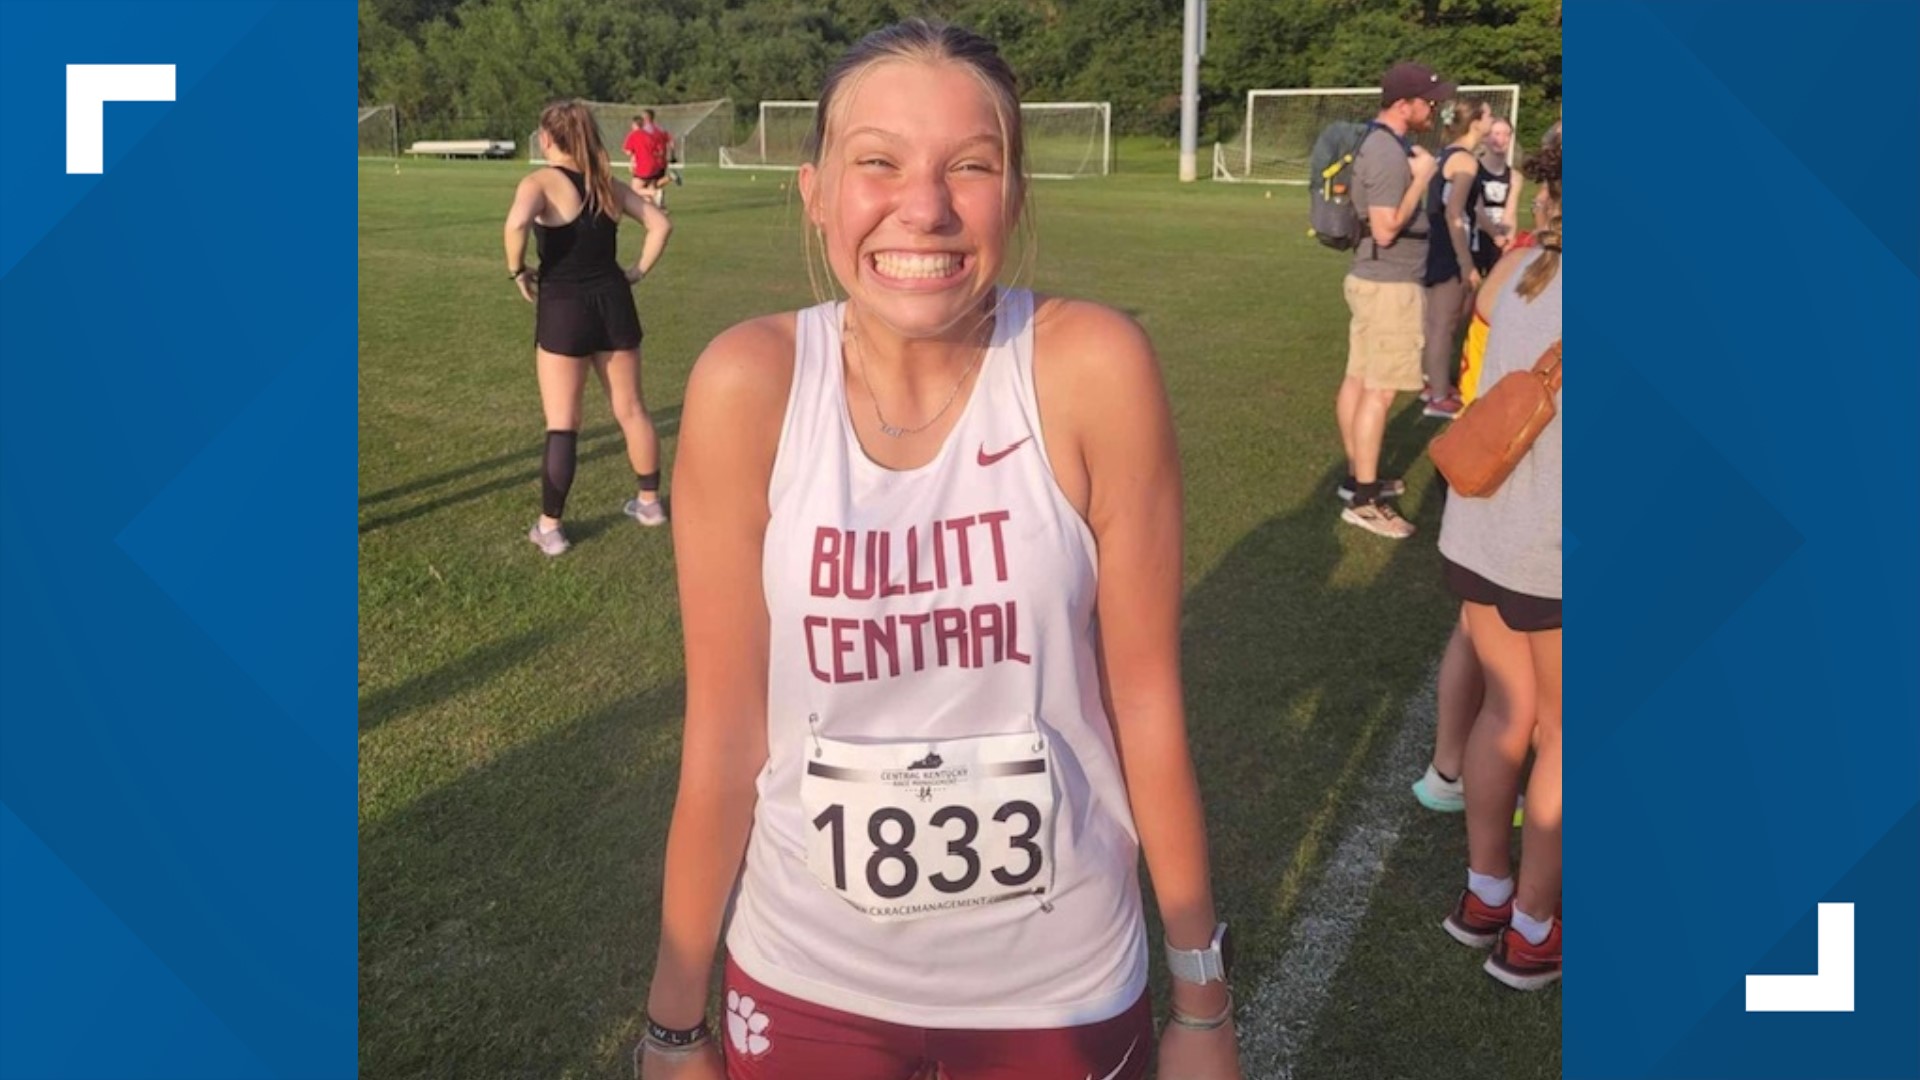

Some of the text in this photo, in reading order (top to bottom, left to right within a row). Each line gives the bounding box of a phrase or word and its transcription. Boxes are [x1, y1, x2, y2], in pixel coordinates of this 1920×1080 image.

[810, 509, 1010, 601] BULLITT
[803, 600, 1031, 684] CENTRAL
[879, 768, 968, 781] CENTRAL KENTUCKY
[812, 800, 1042, 899] 1833
